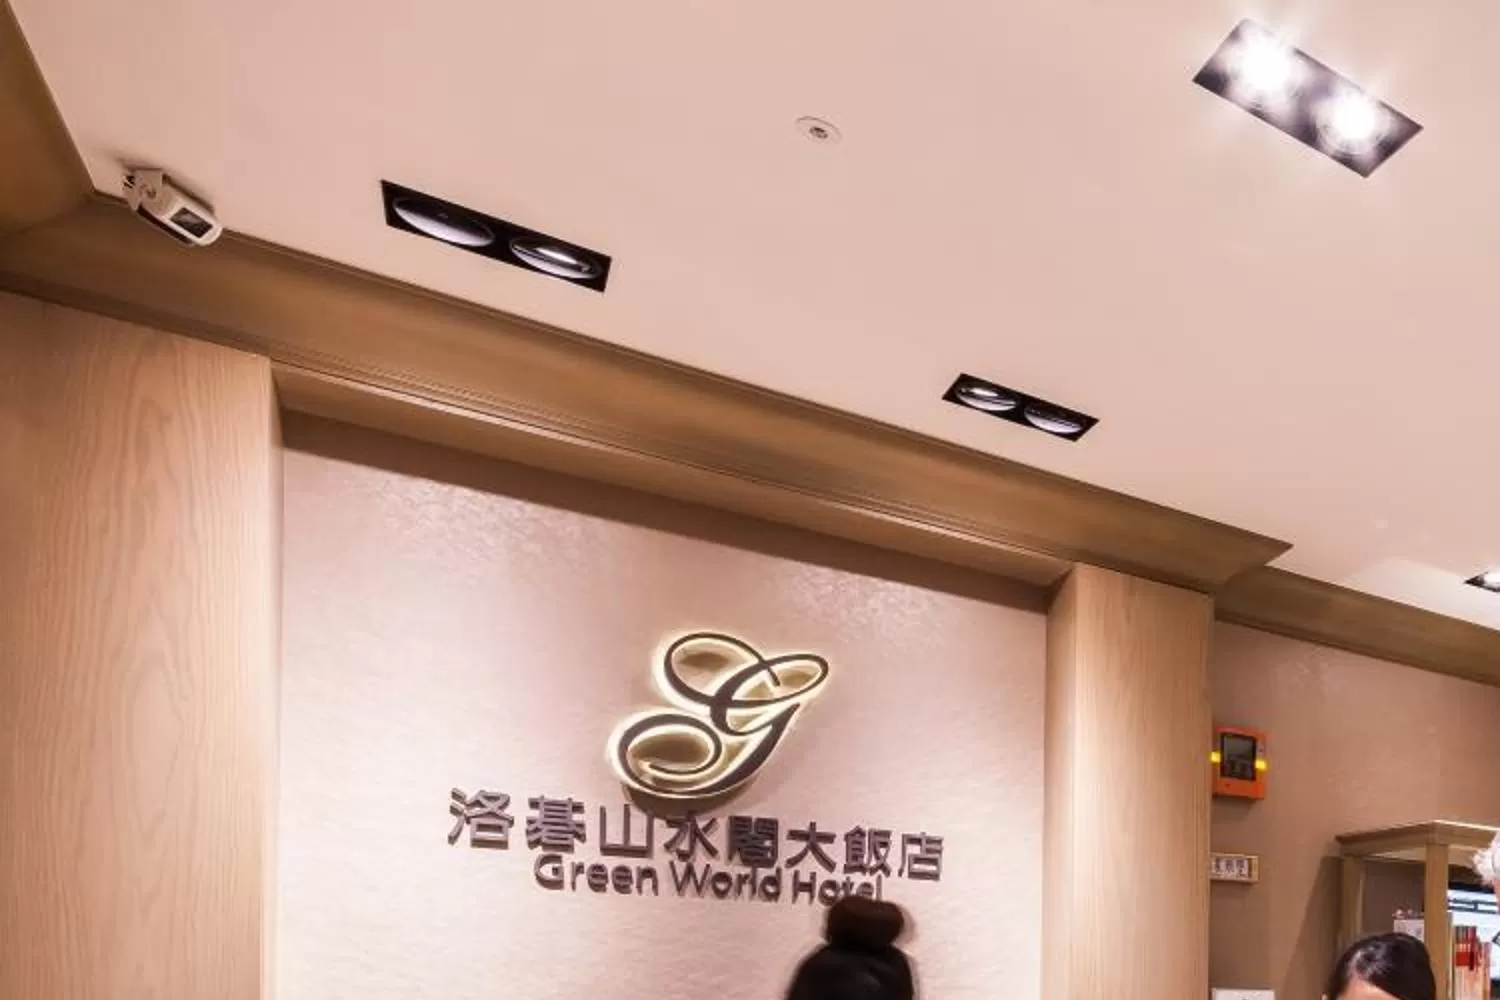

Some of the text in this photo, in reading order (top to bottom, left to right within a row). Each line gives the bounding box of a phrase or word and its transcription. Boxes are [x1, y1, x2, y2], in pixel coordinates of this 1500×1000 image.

[533, 853, 883, 906] Green World Hotel
